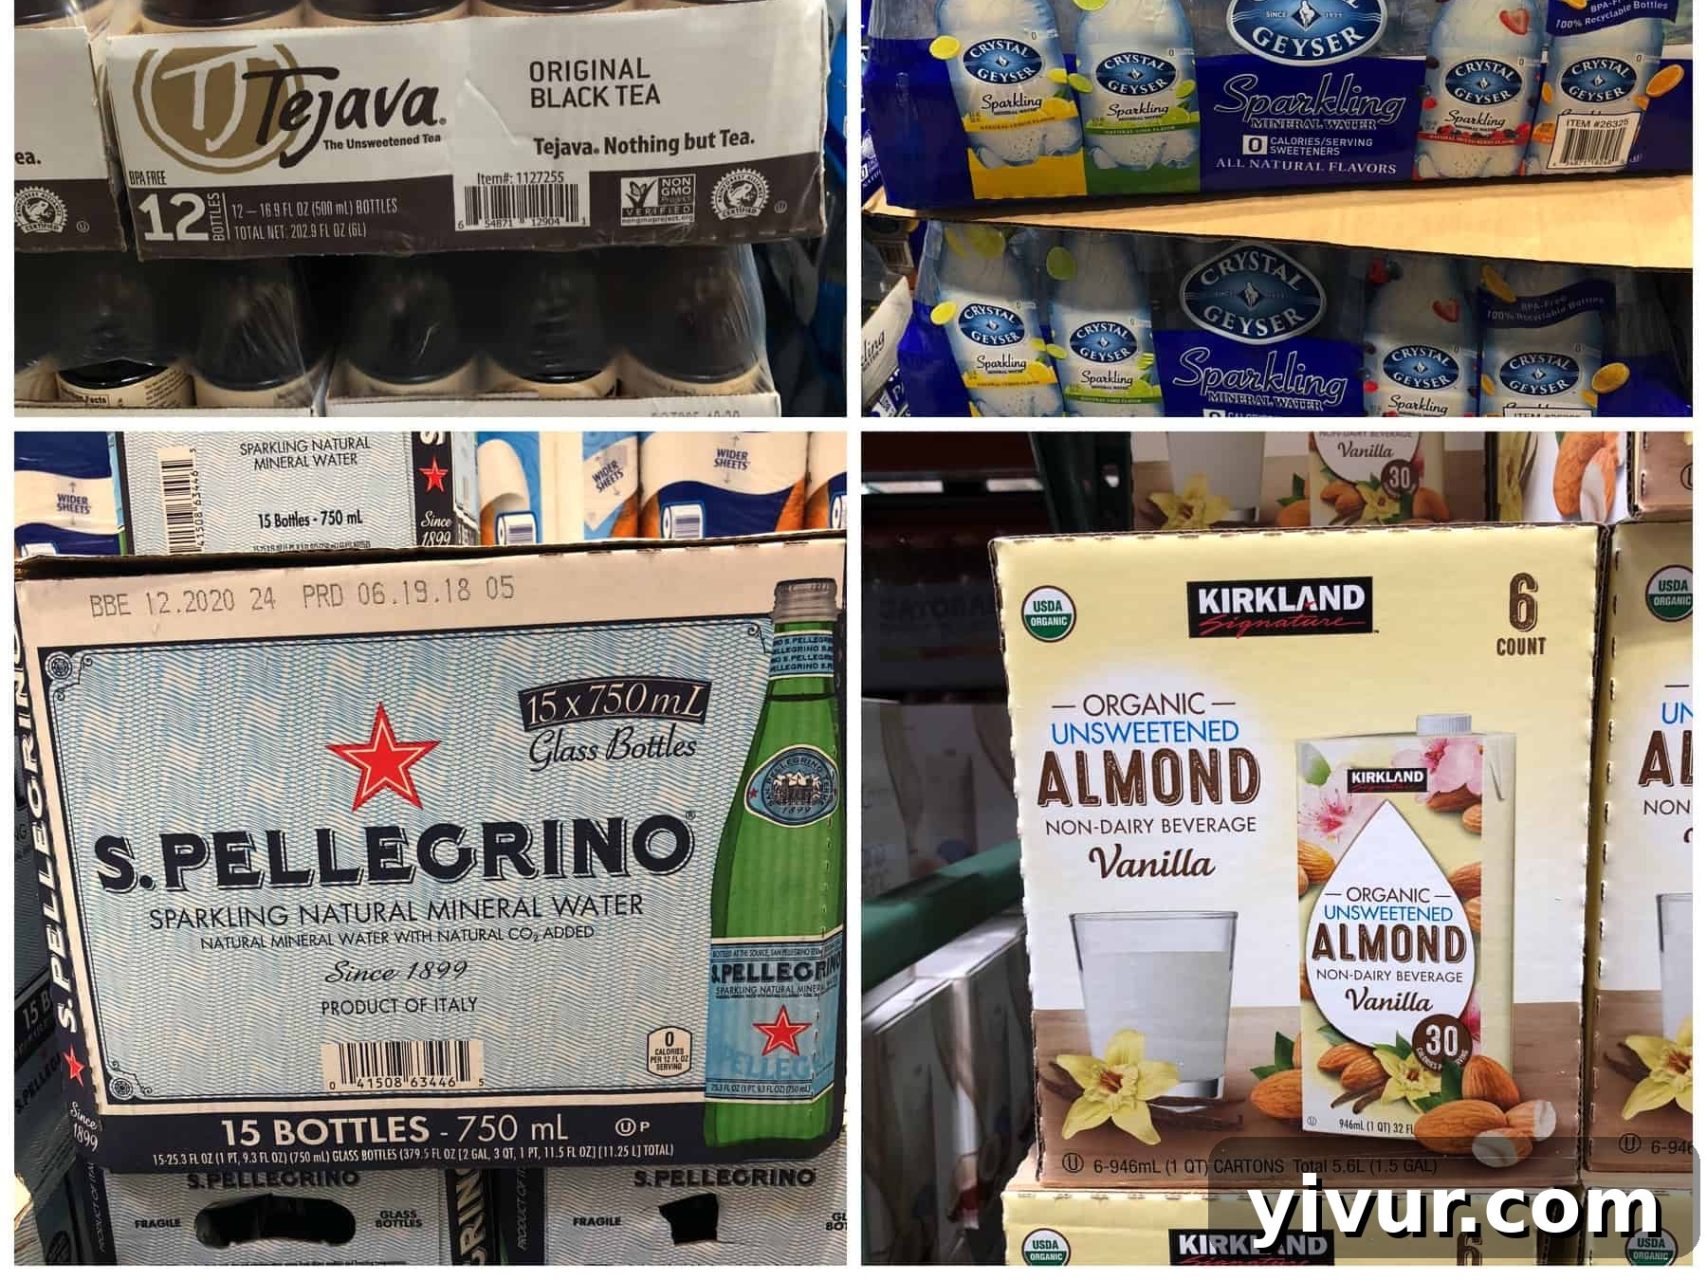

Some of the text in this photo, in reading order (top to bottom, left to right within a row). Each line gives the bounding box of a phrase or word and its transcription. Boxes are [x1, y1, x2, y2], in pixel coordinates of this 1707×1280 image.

[970, 40, 1029, 58] CRYSTAL
[1252, 27, 1365, 57] GEYSER
[530, 57, 651, 83] ORIGINAL
[1104, 54, 1165, 71] CRYSTAL
[977, 67, 1036, 83] GEYSER
[531, 84, 661, 108] BLACK TEA
[981, 93, 1043, 115] Sparkling
[1214, 73, 1406, 124] Sparkling
[242, 66, 448, 169] Tejava
[346, 135, 420, 150] Unsweetened
[604, 129, 755, 155] Nothing but Tea.
[1270, 137, 1373, 147] CALORIES/SERVING
[1270, 147, 1340, 155] SWEETENERS
[1216, 158, 1397, 174] ALL NATURAL FLAVORS
[516, 171, 564, 184] 1127255
[137, 193, 209, 242] 12
[1200, 247, 1305, 291] CRYSTAL
[1203, 306, 1305, 337] GEYSER
[1172, 347, 1349, 407] Sparkling
[240, 436, 371, 456] SPARKLING NATURAL
[717, 448, 748, 460] WIDER
[1338, 441, 1395, 459] Vanilla
[253, 452, 358, 471] MINERAL WATER
[714, 457, 748, 470] SHEETS
[57, 494, 89, 505] WIDER
[57, 503, 91, 515] SHEETS
[90, 575, 515, 618] BBE 12.2020 24 PRD 06.19.18 05
[1658, 580, 1688, 593] USDA
[1033, 600, 1063, 613] USDA
[1199, 584, 1365, 614] KIRKLAND
[1509, 572, 1539, 632] 6
[1653, 596, 1691, 607] ORGANIC
[1030, 615, 1067, 627] ORGANIC
[1497, 637, 1547, 656] COUNT
[588, 682, 647, 716] 750
[1083, 692, 1206, 716] ORGANIC
[1051, 720, 1239, 745] UNSWEETENED
[529, 723, 697, 772] Glass Bottles
[1037, 747, 1261, 808] ALMOND
[1352, 771, 1424, 784] KIRKLAND
[1046, 817, 1256, 836] NON-DAIRY BEVERAGE
[95, 814, 695, 895] S.PELLEGRINO
[1088, 840, 1215, 879] Vanilla
[1346, 887, 1430, 903] ORGANIC
[149, 894, 644, 931] SPARKLING NATURAL MINERAL WATER
[1324, 905, 1453, 921] UNSWEETENED
[200, 925, 595, 950] NATURAL MINERAL WATER WITH NATURAL ADDED
[1311, 922, 1467, 964] ALMOND
[324, 959, 469, 984] Since 1899
[1316, 969, 1463, 983] NON-DAIRY BEVERAGE
[322, 997, 478, 1016] PRODUCT OF ITALY
[1345, 986, 1434, 1012] Vanilla
[1426, 1025, 1458, 1056] 30
[221, 1115, 518, 1147] 15 BOTTLES 750
[1093, 1158, 1284, 1174] 6-946mL CARTONS
[1033, 1240, 1059, 1250] USDA
[1030, 1252, 1063, 1261] ORGANIC
